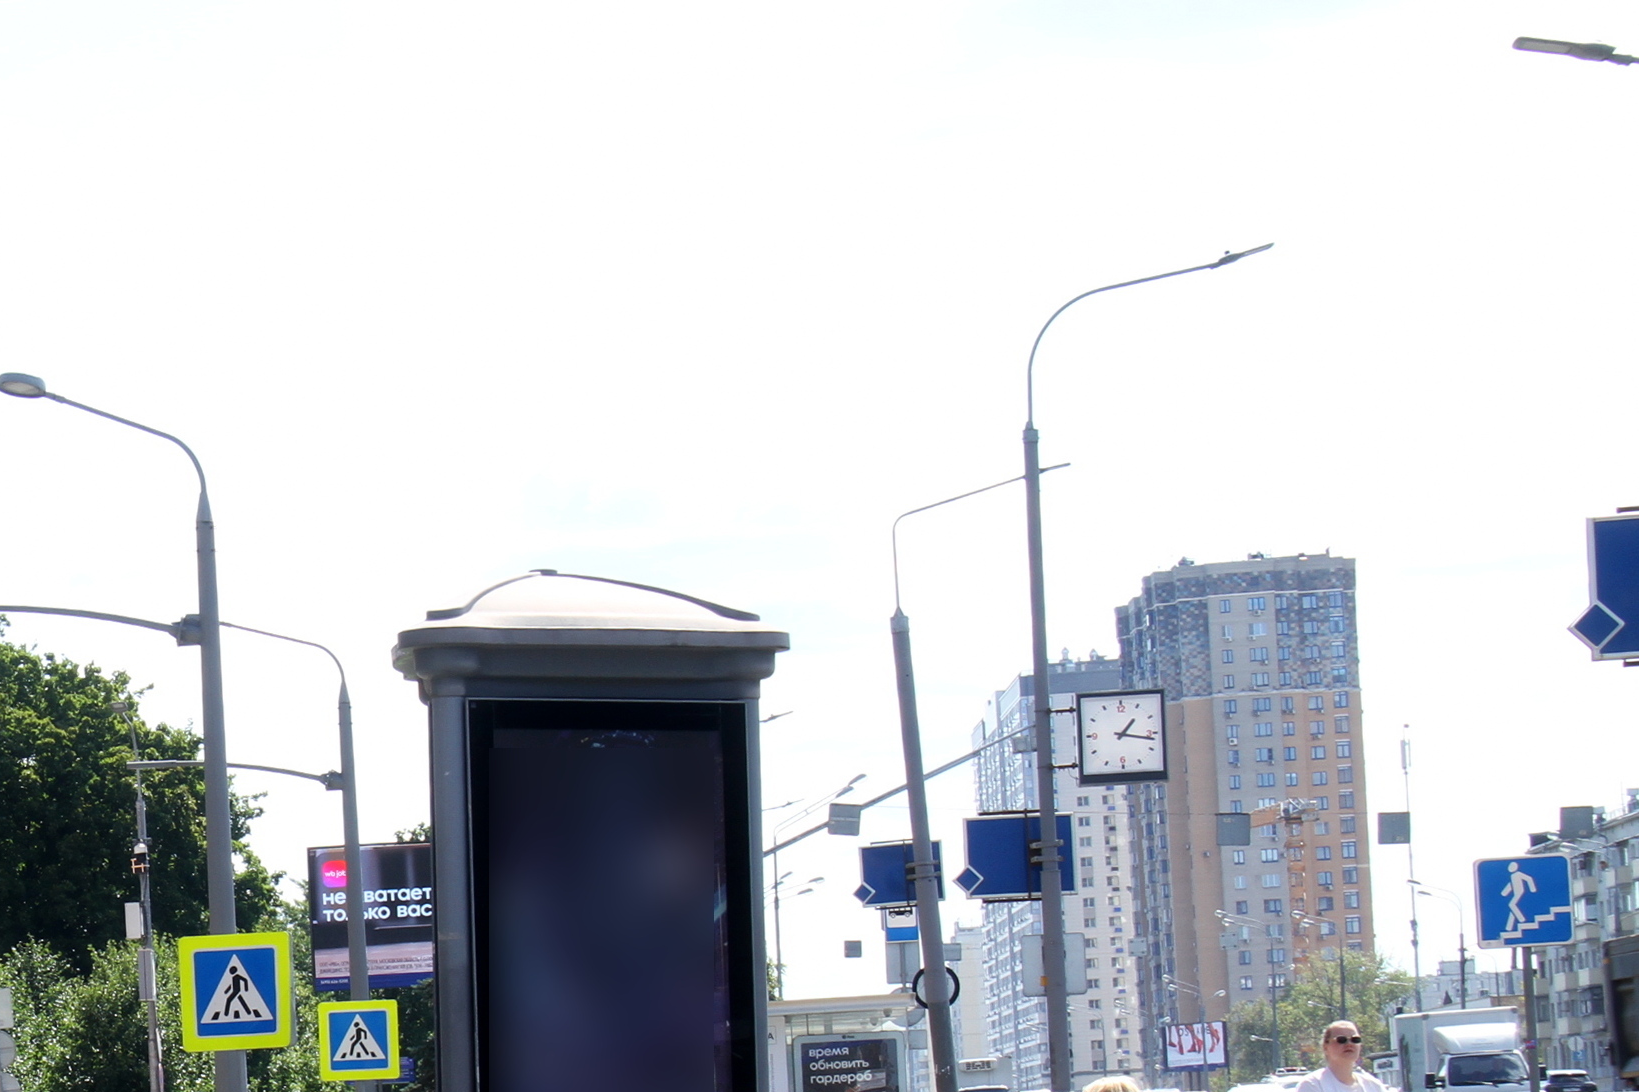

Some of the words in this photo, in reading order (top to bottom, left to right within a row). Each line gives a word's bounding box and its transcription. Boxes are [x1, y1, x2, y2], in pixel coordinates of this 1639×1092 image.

[1117, 705, 1126, 713] 12
[1092, 732, 1098, 740] 9
[1146, 729, 1152, 737] 3
[1119, 756, 1126, 764] 6
[323, 892, 346, 905] не
[364, 887, 432, 903] ватает
[396, 903, 433, 918] вас
[808, 1046, 849, 1059] время
[809, 1059, 870, 1071] обновить
[810, 1069, 873, 1086] гардероб
